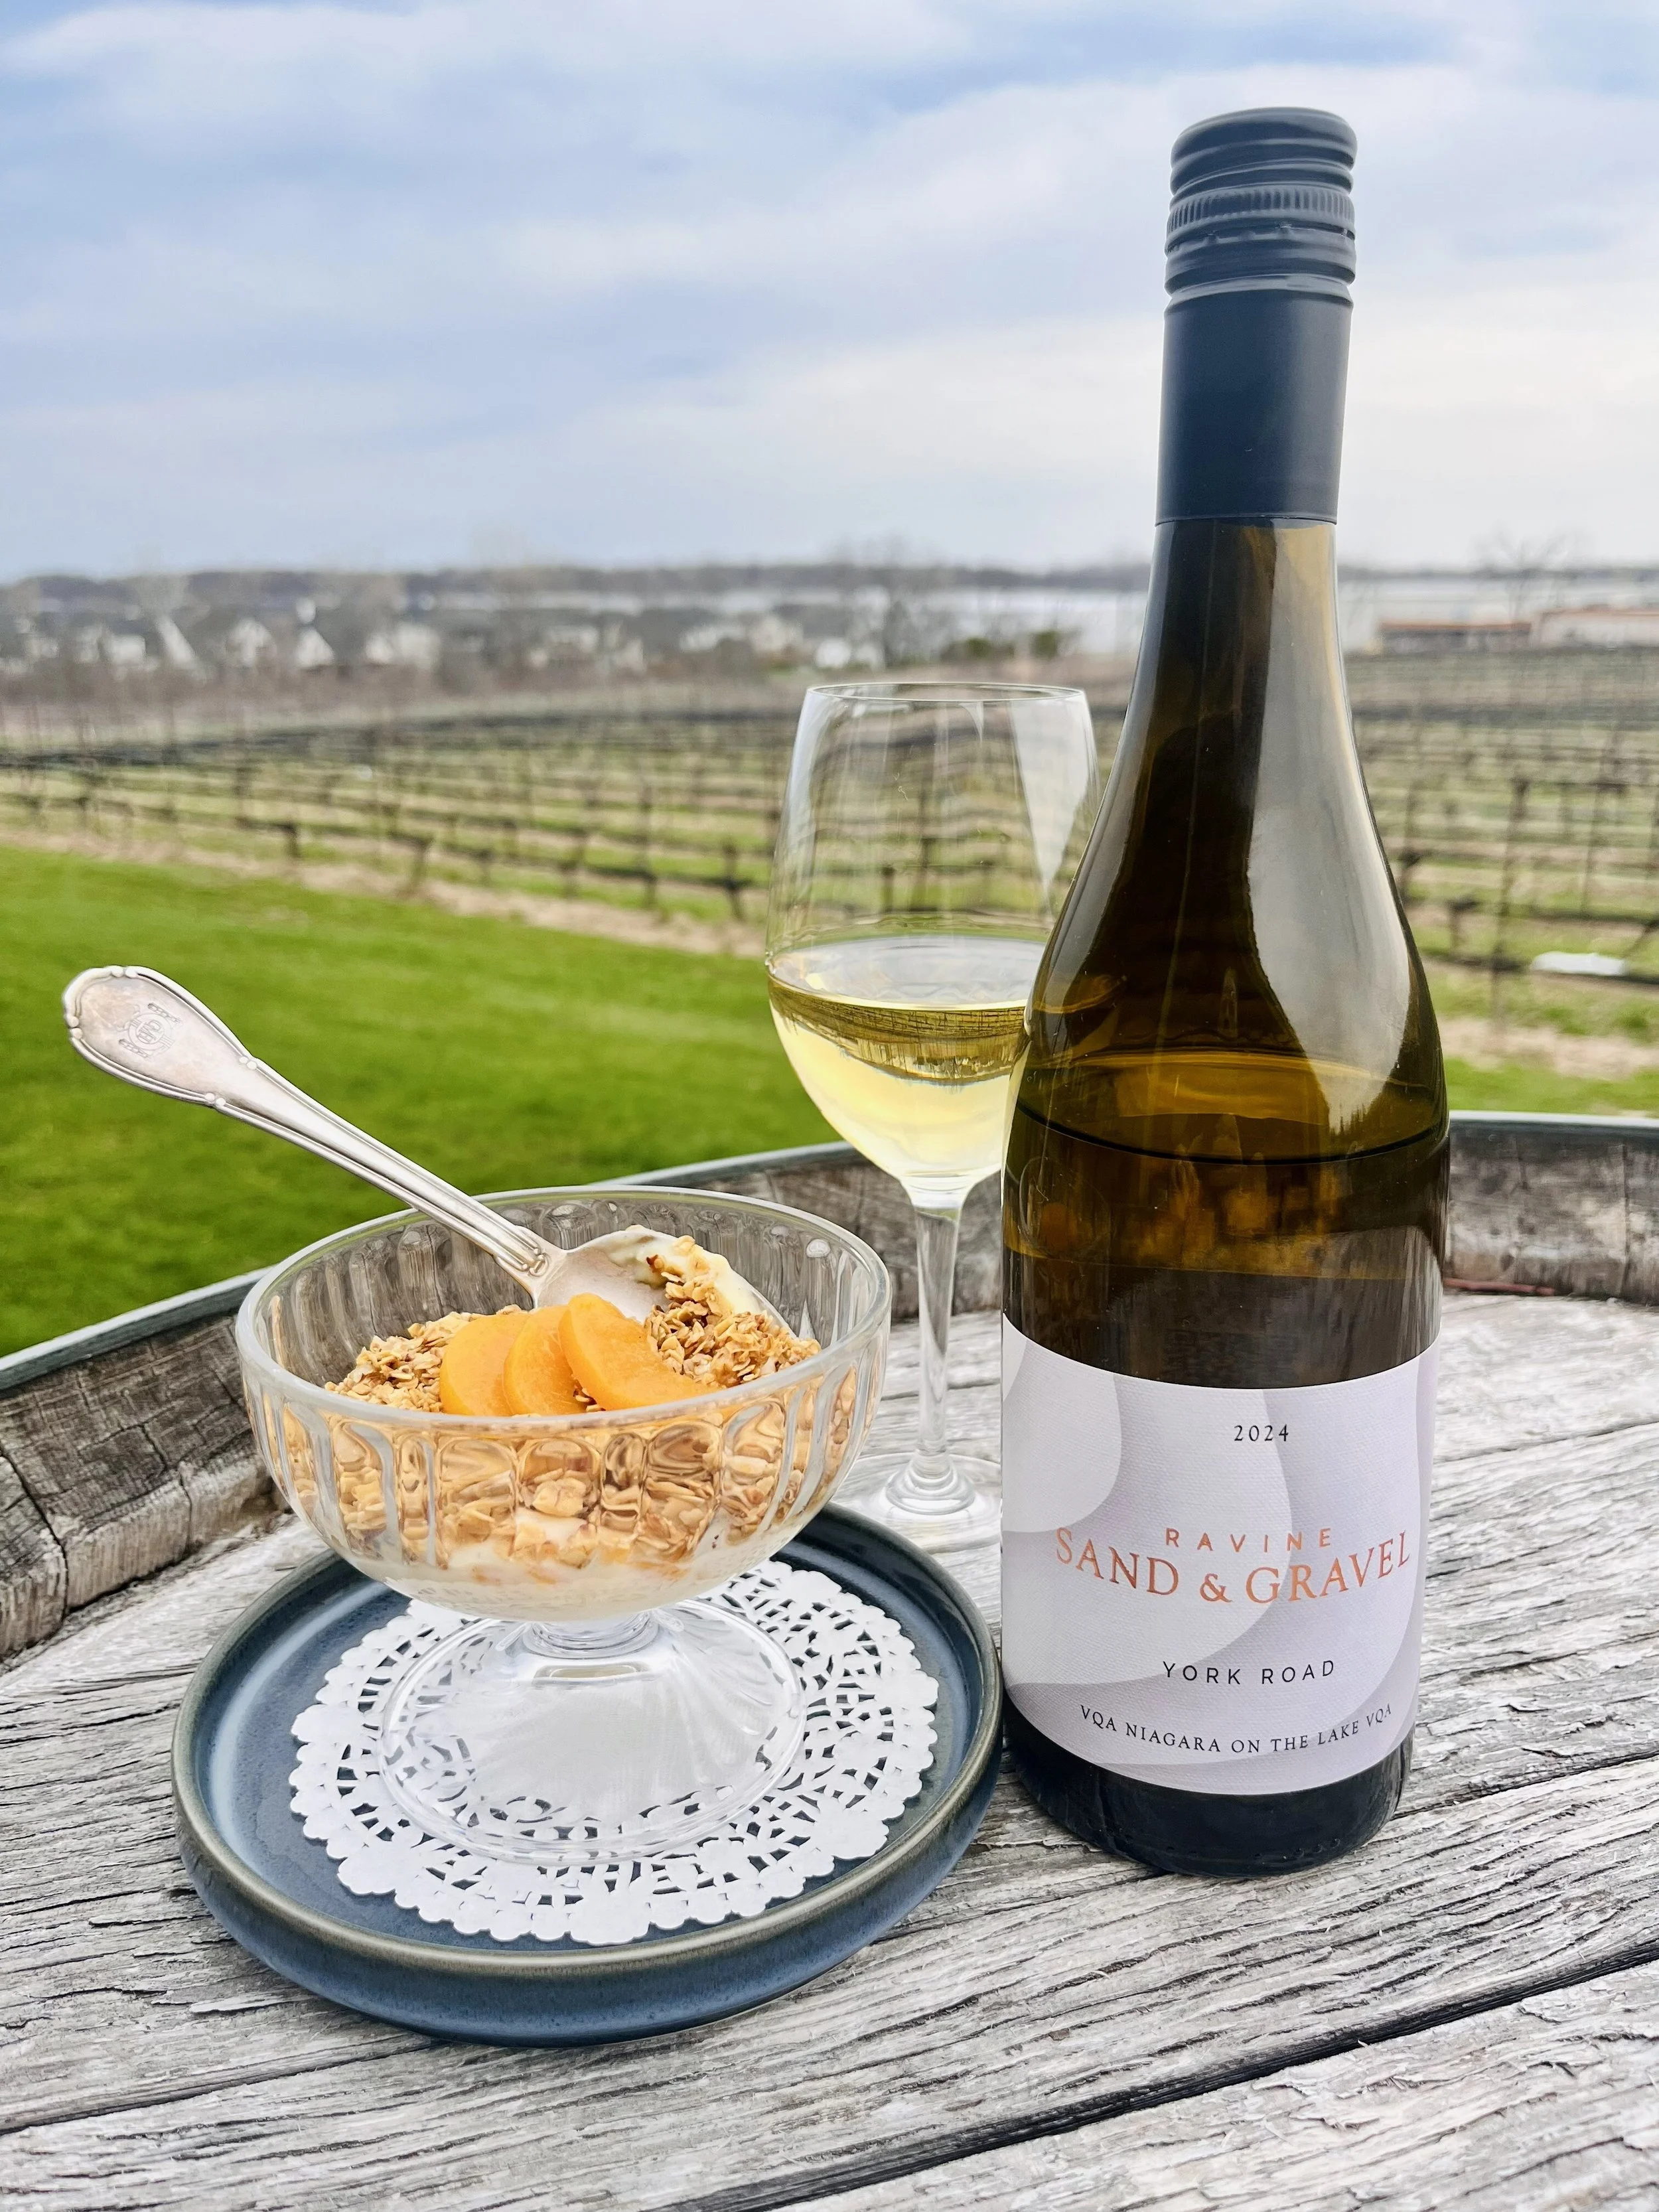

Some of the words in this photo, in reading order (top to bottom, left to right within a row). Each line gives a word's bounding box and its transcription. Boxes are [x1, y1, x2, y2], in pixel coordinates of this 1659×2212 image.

[1234, 1424, 1289, 1441] 2024
[1166, 1528, 1331, 1552] RAVINE
[1056, 1527, 1179, 1595] SAND
[1200, 1573, 1232, 1603] &
[1246, 1530, 1410, 1603] GRAVEL
[1163, 1661, 1240, 1684] YORK
[1262, 1660, 1334, 1684] ROAD
[1080, 1704, 1117, 1732] VQA
[1125, 1722, 1221, 1752] NIAGARA
[1232, 1739, 1260, 1753] ON
[1270, 1735, 1309, 1752] THE
[1318, 1720, 1359, 1745] LAKE
[1366, 1703, 1392, 1728] VQA
